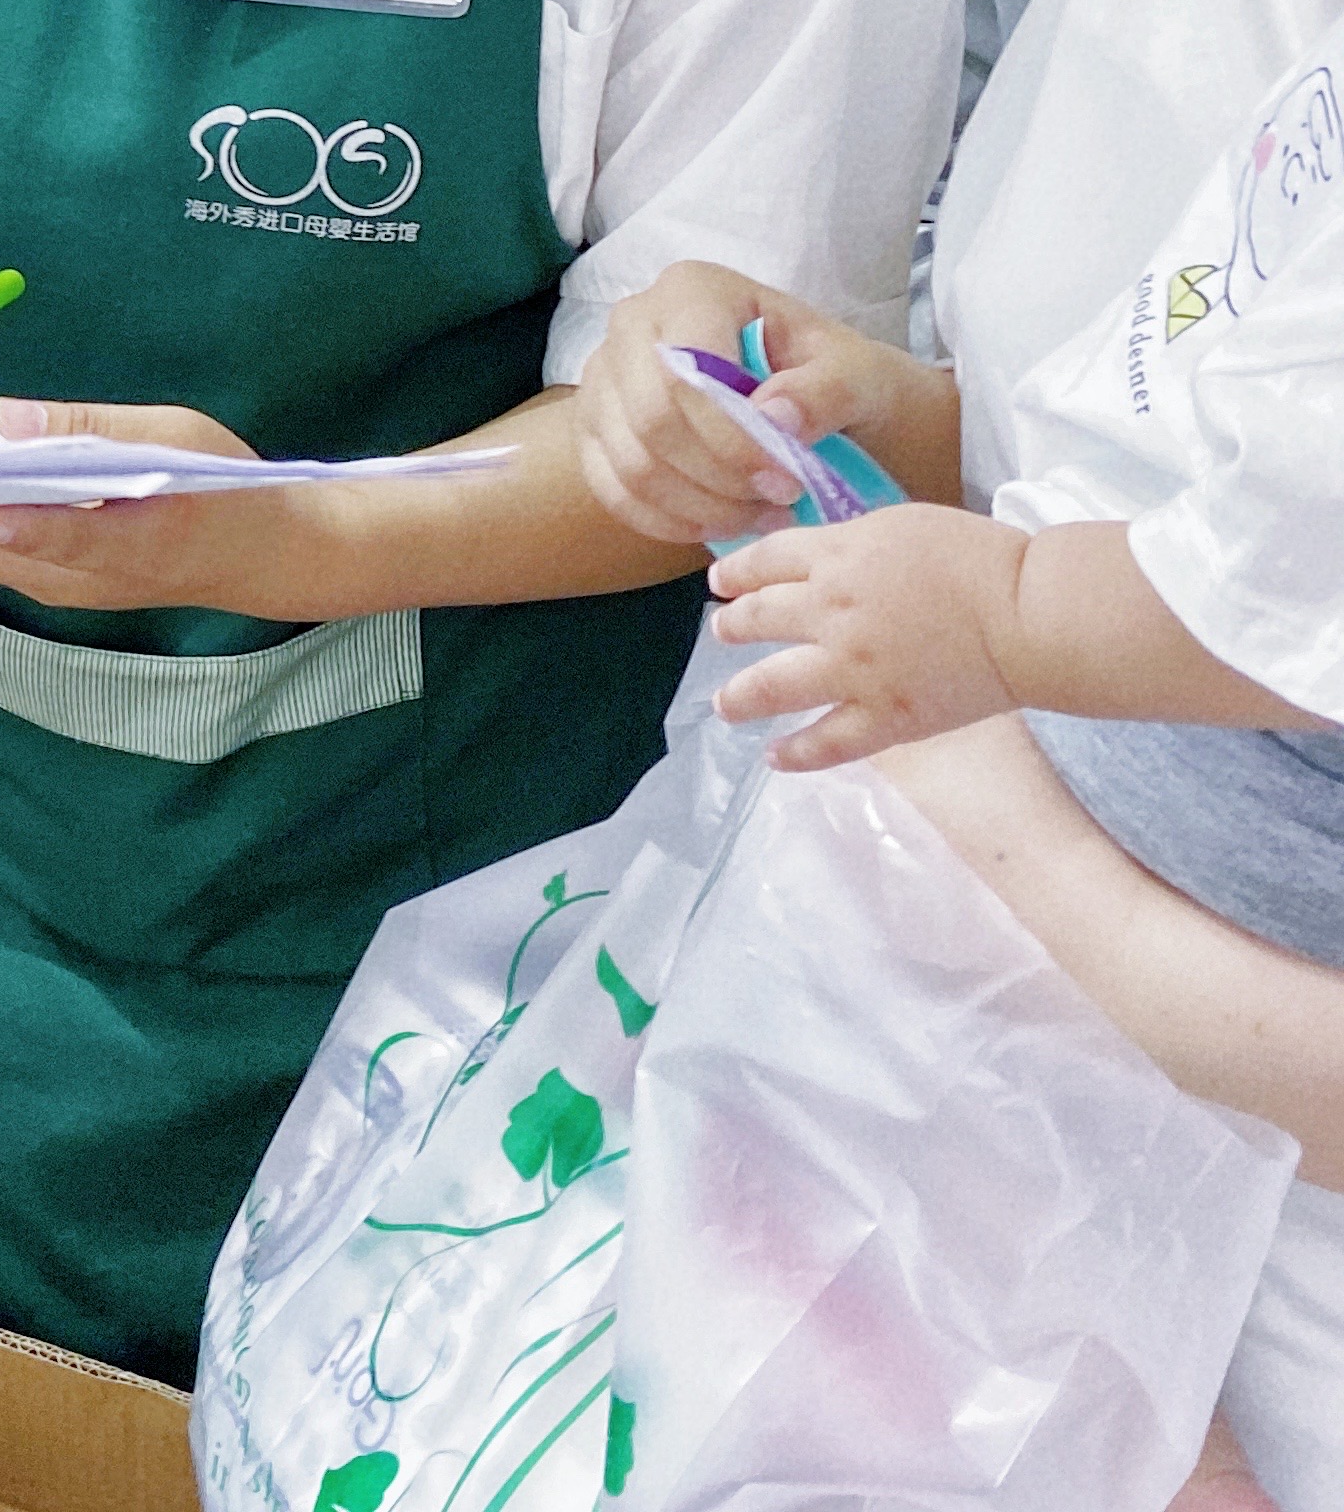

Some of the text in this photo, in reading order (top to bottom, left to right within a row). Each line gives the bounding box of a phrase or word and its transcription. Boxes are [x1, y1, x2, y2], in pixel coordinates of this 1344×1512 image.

[184, 198, 422, 243] 海外秀进口母婴生活馆
